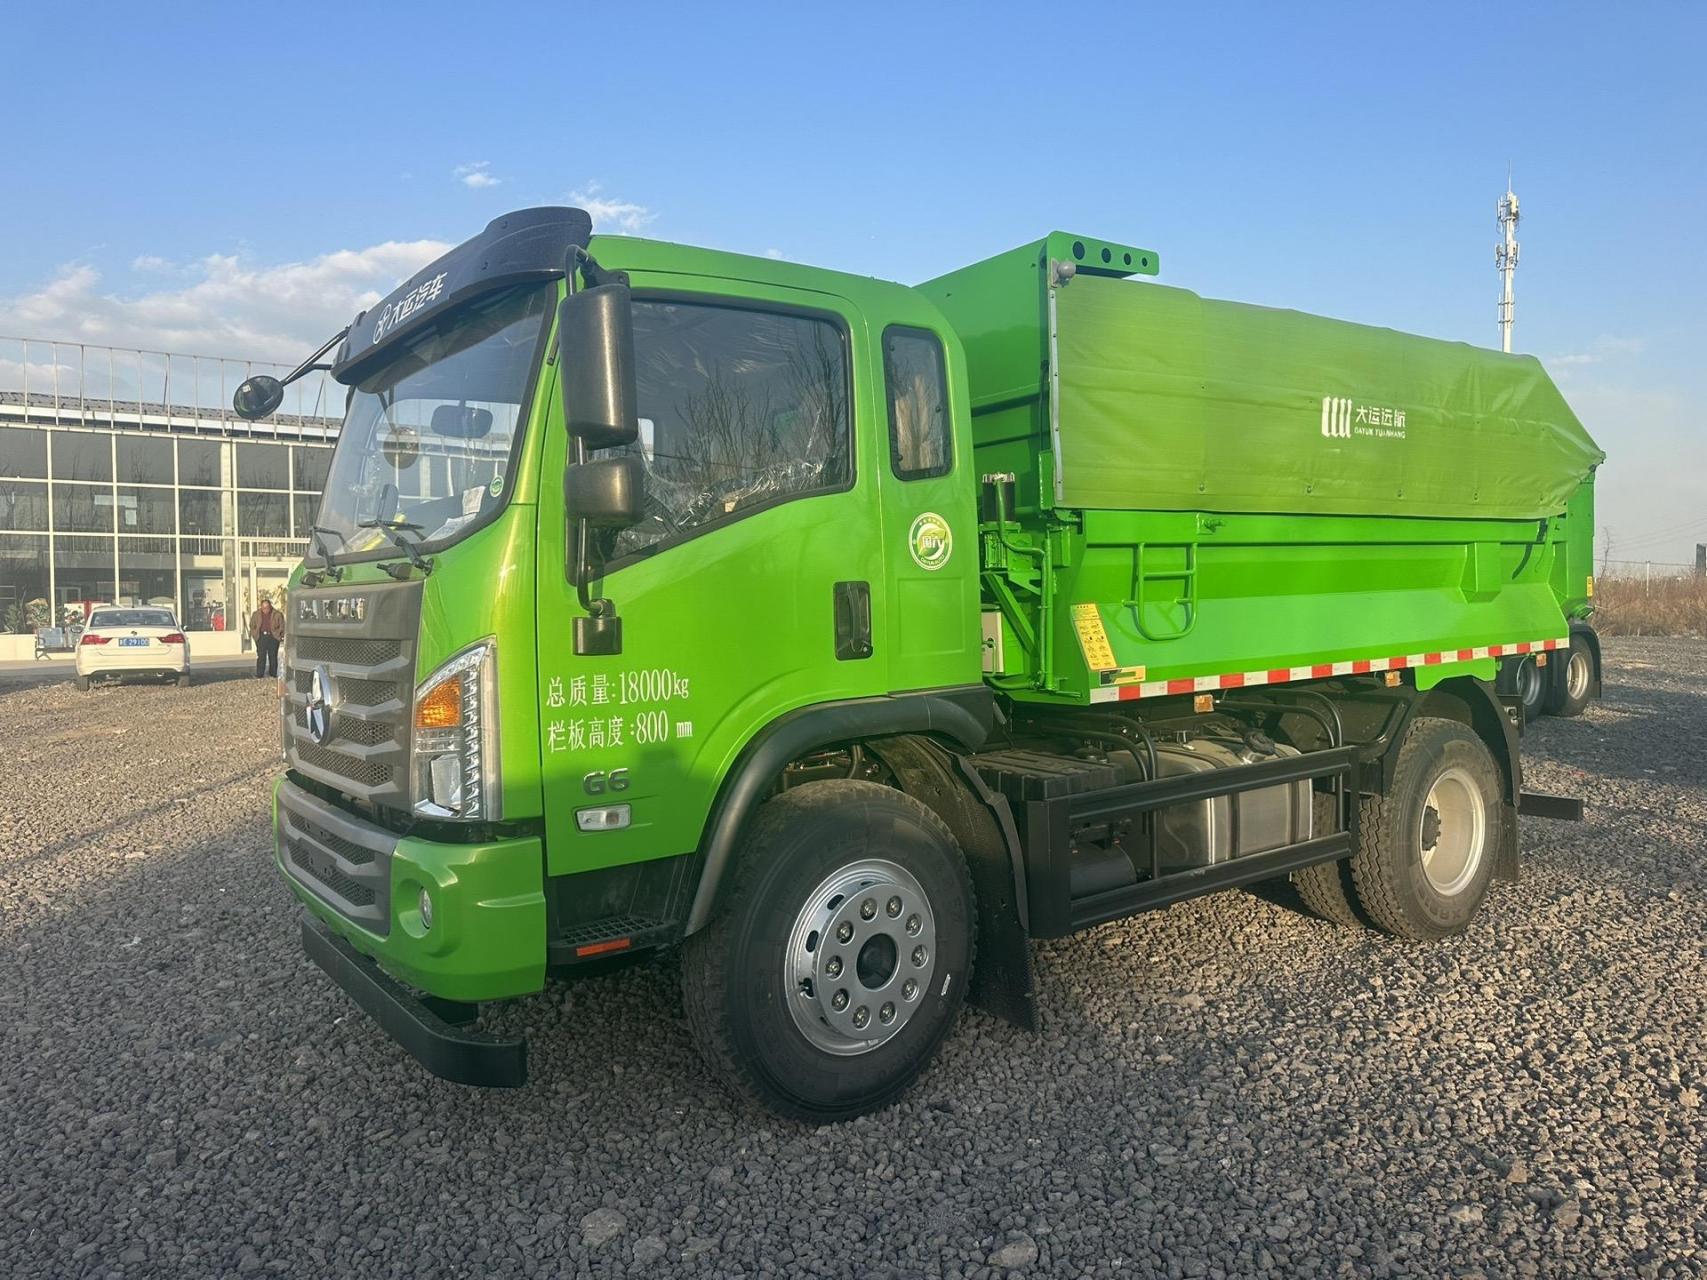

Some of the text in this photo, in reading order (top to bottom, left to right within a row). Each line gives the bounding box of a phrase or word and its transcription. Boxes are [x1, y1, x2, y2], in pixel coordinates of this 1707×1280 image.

[387, 271, 449, 330] 大运汽车
[1355, 404, 1406, 429] 大运远航
[583, 767, 630, 796] G6
